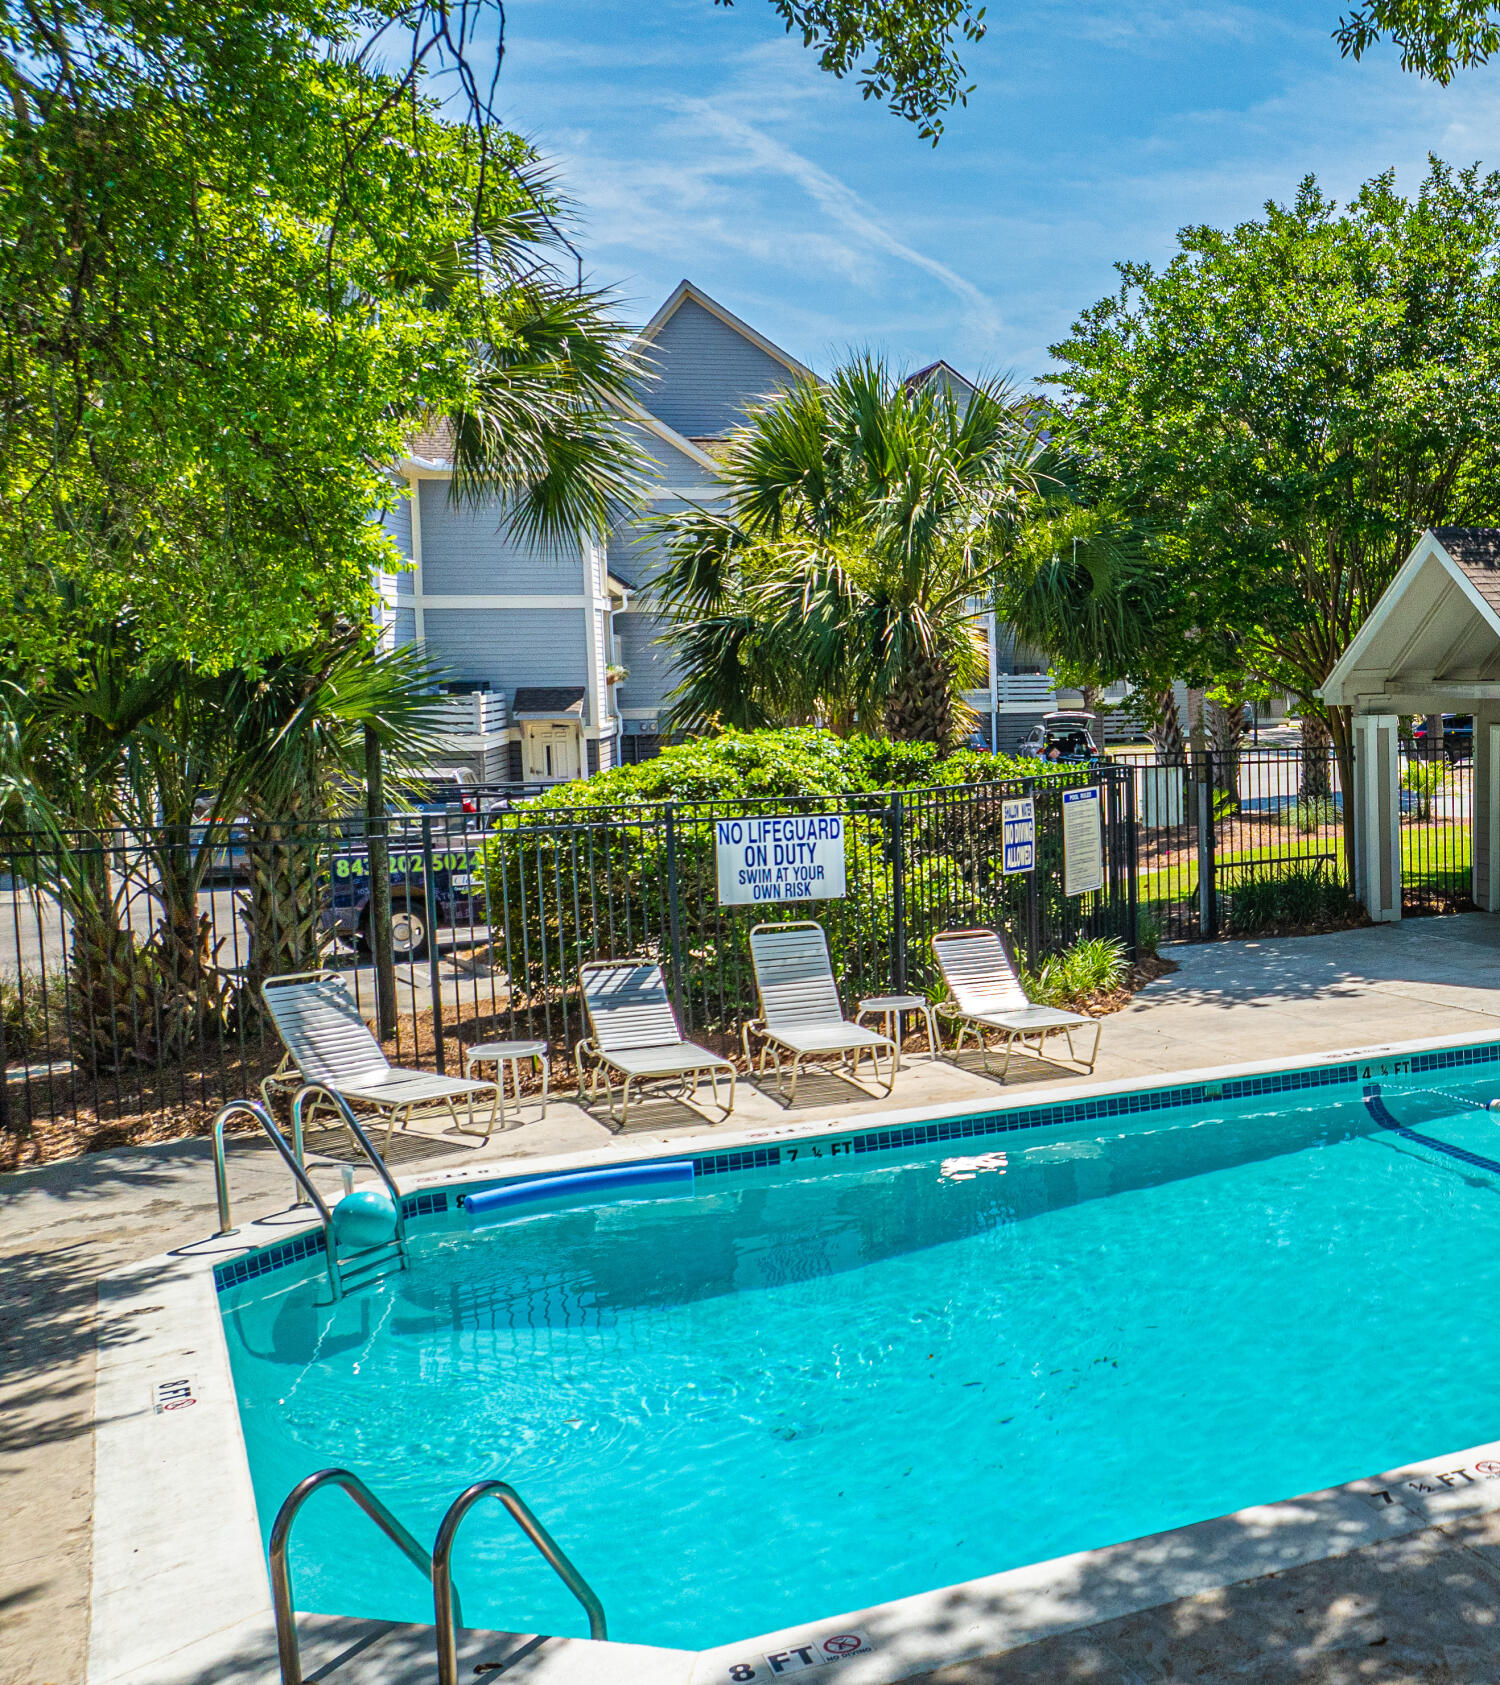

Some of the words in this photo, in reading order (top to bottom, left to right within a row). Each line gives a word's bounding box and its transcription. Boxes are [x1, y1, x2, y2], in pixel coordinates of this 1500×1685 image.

[718, 822, 743, 845] NO
[747, 817, 840, 844] LIFEGUARD
[1005, 823, 1013, 845] NO
[1014, 821, 1032, 844] DIVING
[389, 855, 424, 873] 202
[744, 844, 767, 868] ON
[774, 842, 816, 866] DUTY
[1006, 845, 1032, 868] ALLOWED
[739, 868, 772, 885] SWIM
[776, 867, 789, 883] AT
[793, 865, 825, 881] YOUR
[753, 883, 780, 900] OWN
[784, 881, 812, 898] RISK
[1362, 1066, 1372, 1079] 4
[1394, 1061, 1410, 1075] FT
[787, 1149, 798, 1162] 7
[831, 1141, 852, 1156] FT
[159, 1379, 190, 1389] 8
[159, 1386, 191, 1401] FT
[1370, 1491, 1393, 1504] 7
[1435, 1468, 1475, 1487] FT
[729, 1663, 756, 1682] 8
[767, 1645, 814, 1673] FT
[826, 1654, 840, 1662] NO
[841, 1646, 873, 1659] DIVING
